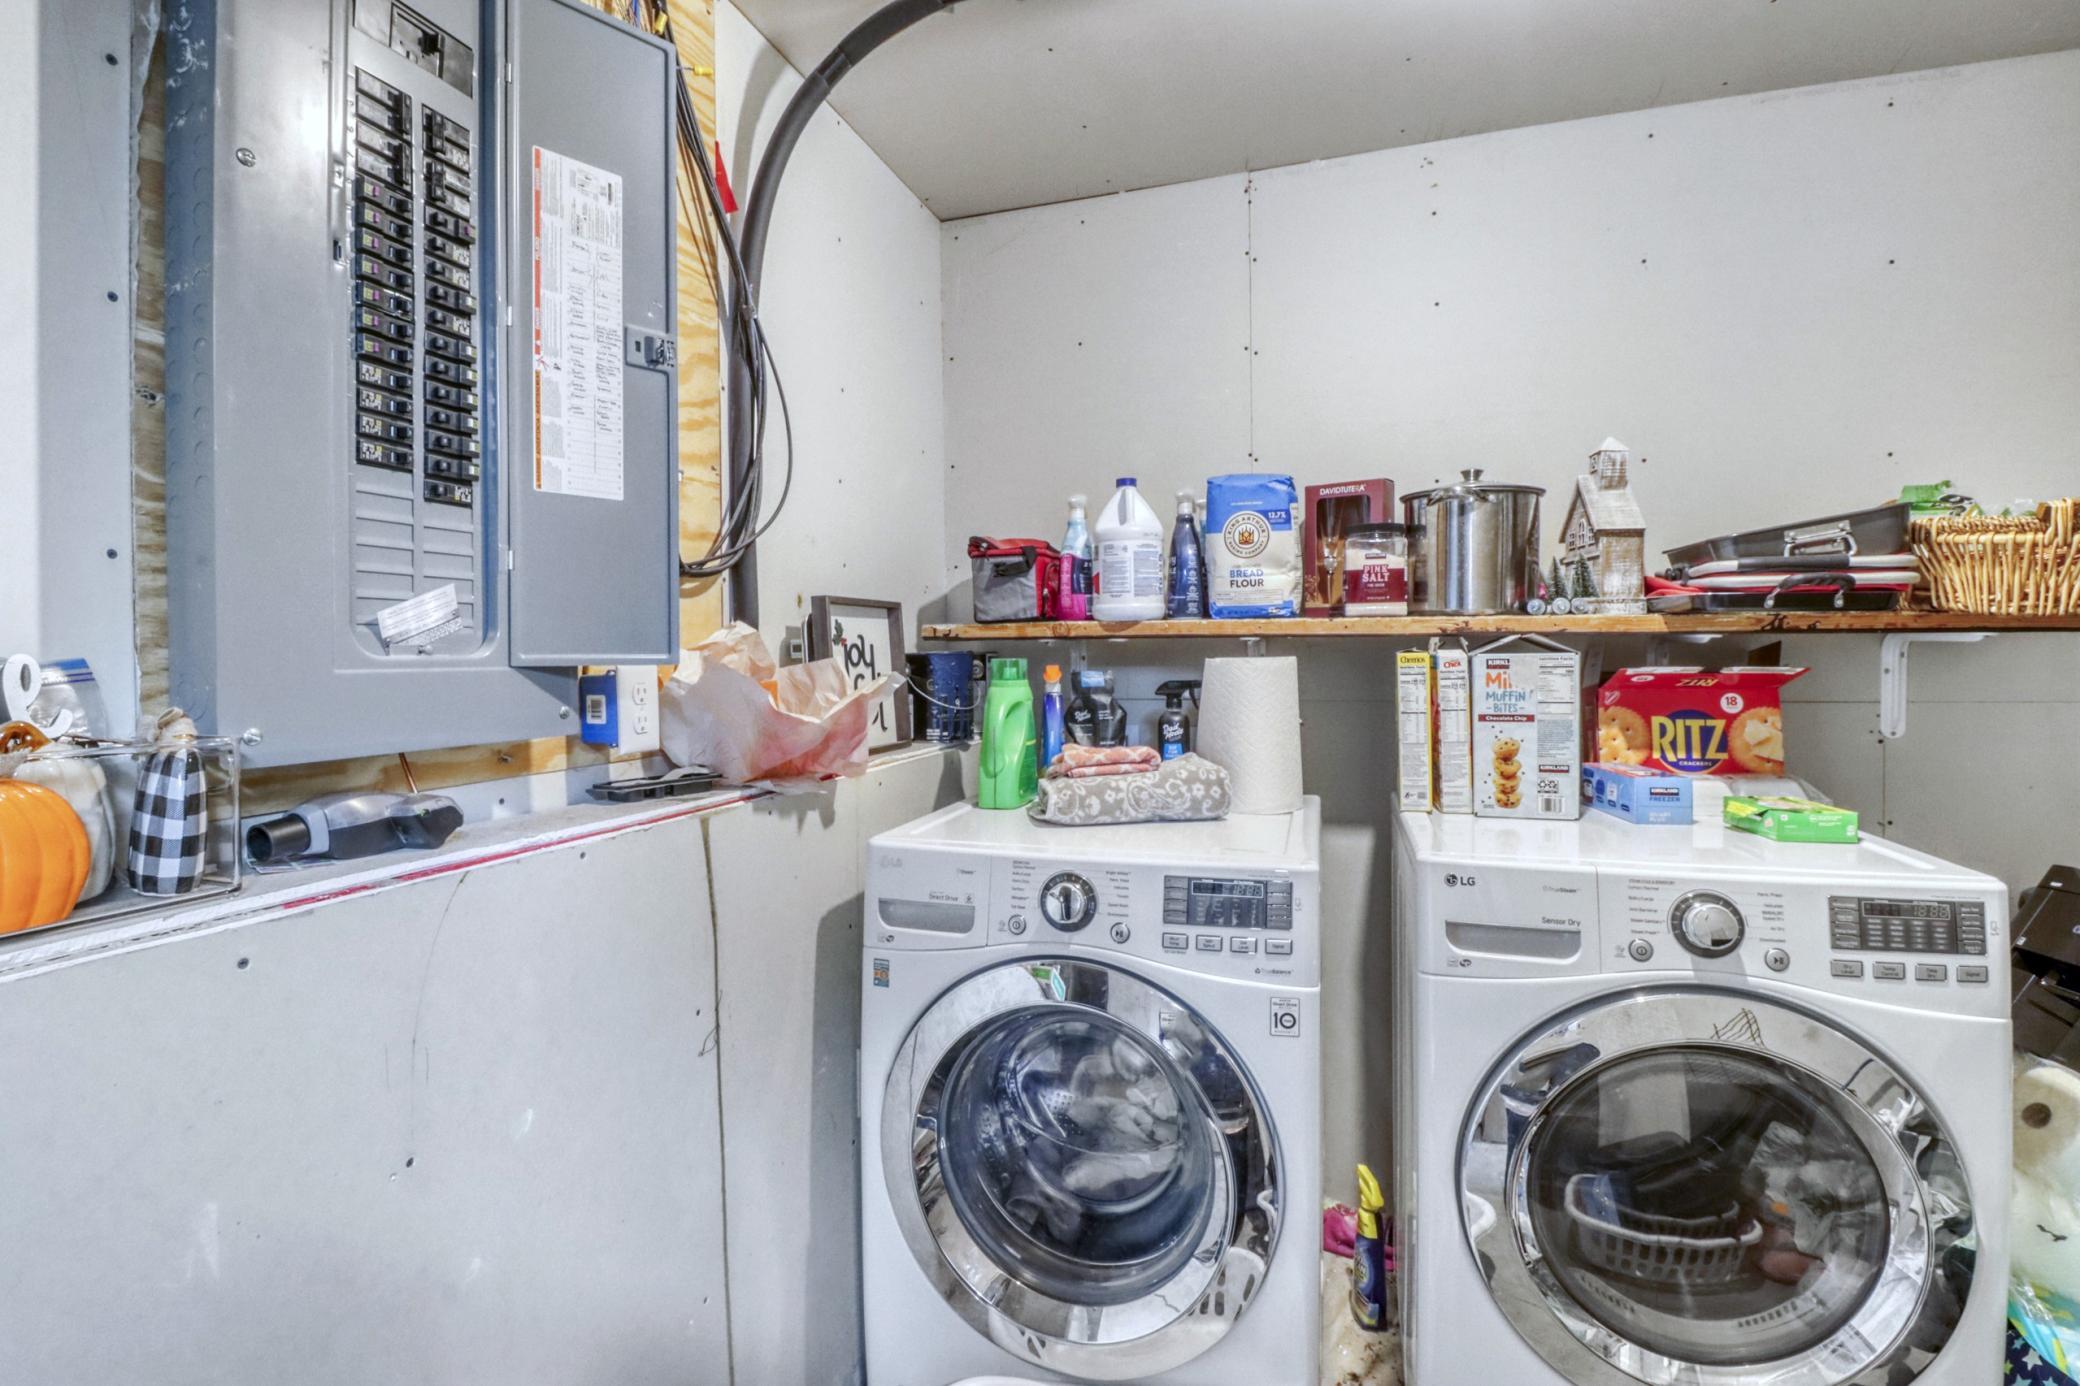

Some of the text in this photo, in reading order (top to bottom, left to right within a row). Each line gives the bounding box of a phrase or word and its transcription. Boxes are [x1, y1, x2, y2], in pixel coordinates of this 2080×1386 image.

[1227, 516, 1267, 536] KING ARTHUR
[1229, 569, 1264, 578] BREAD
[1363, 565, 1388, 573] PINK
[1362, 573, 1390, 582] SALT
[1229, 579, 1265, 588] FLOUR
[1675, 678, 1719, 687] RITZ
[1725, 696, 1738, 706] 18
[1650, 715, 1729, 762] RITZ
[1460, 876, 1476, 886] LG
[1542, 916, 1581, 927] Sensor Dry
[1273, 1012, 1297, 1029] 10
